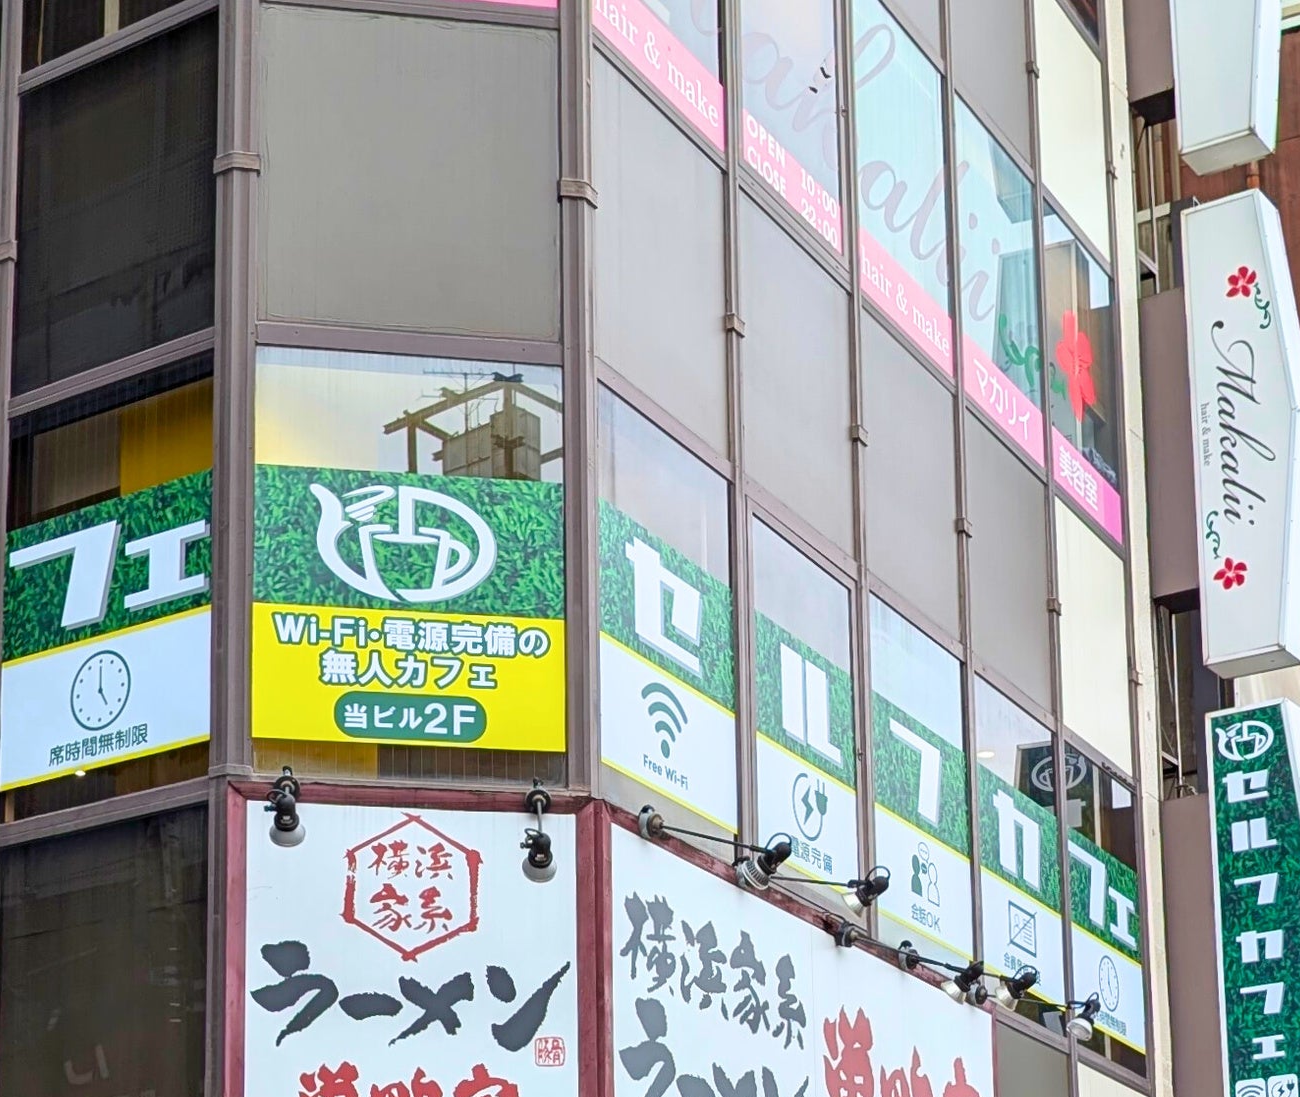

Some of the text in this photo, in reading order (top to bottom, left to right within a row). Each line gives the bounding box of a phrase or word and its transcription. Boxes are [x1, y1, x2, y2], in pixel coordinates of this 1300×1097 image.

[643, 32, 661, 70] &
[667, 60, 719, 127] make
[747, 114, 838, 219] OPEN 10:00
[748, 146, 838, 247] CLOSE 22:00
[860, 248, 950, 356] hair & make
[1200, 402, 1210, 422] hair
[1211, 320, 1276, 526] Makalii
[1059, 446, 1099, 512] 美容室
[1201, 438, 1211, 467] make
[320, 650, 498, 690] 無人カフェ
[49, 723, 149, 768] 席時間無制限
[343, 702, 478, 736] 当ビル2F
[643, 754, 689, 791] Free Wi-Fi
[368, 840, 454, 880] 横浜
[369, 883, 454, 934] 家系
[911, 903, 941, 933] 会話OK
[1222, 768, 1286, 1062] セルフカフェ
[250, 940, 572, 1052] ラーメン
[620, 891, 806, 1050] 横浜家系
